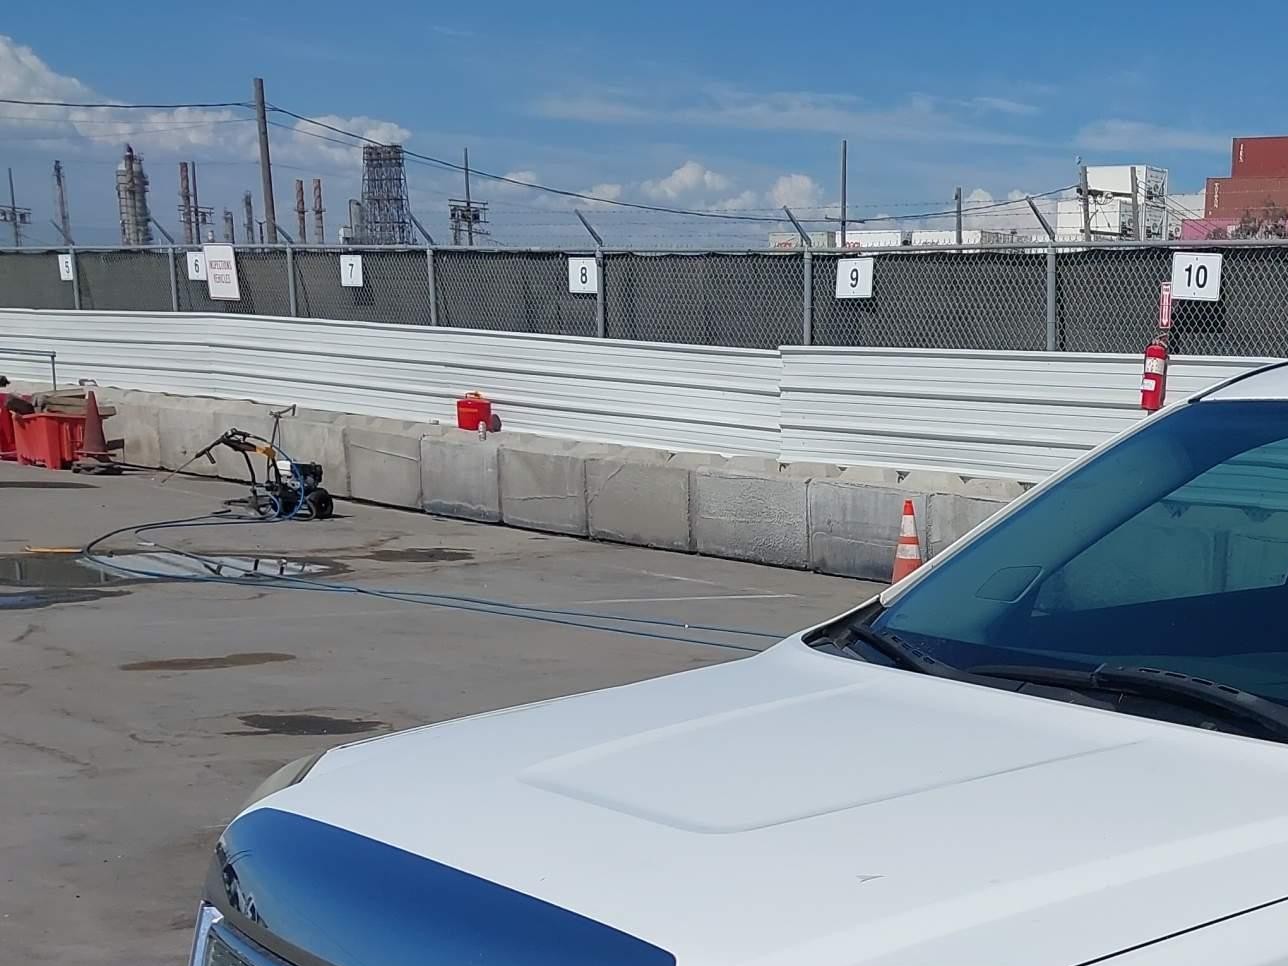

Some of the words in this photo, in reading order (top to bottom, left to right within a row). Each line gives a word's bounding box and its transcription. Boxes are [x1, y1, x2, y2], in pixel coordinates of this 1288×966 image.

[65, 261, 70, 274] 5
[194, 259, 200, 273] 6
[348, 263, 355, 278] 7
[580, 266, 588, 285] 8
[850, 268, 859, 288] 9
[1185, 264, 1208, 289] 10
